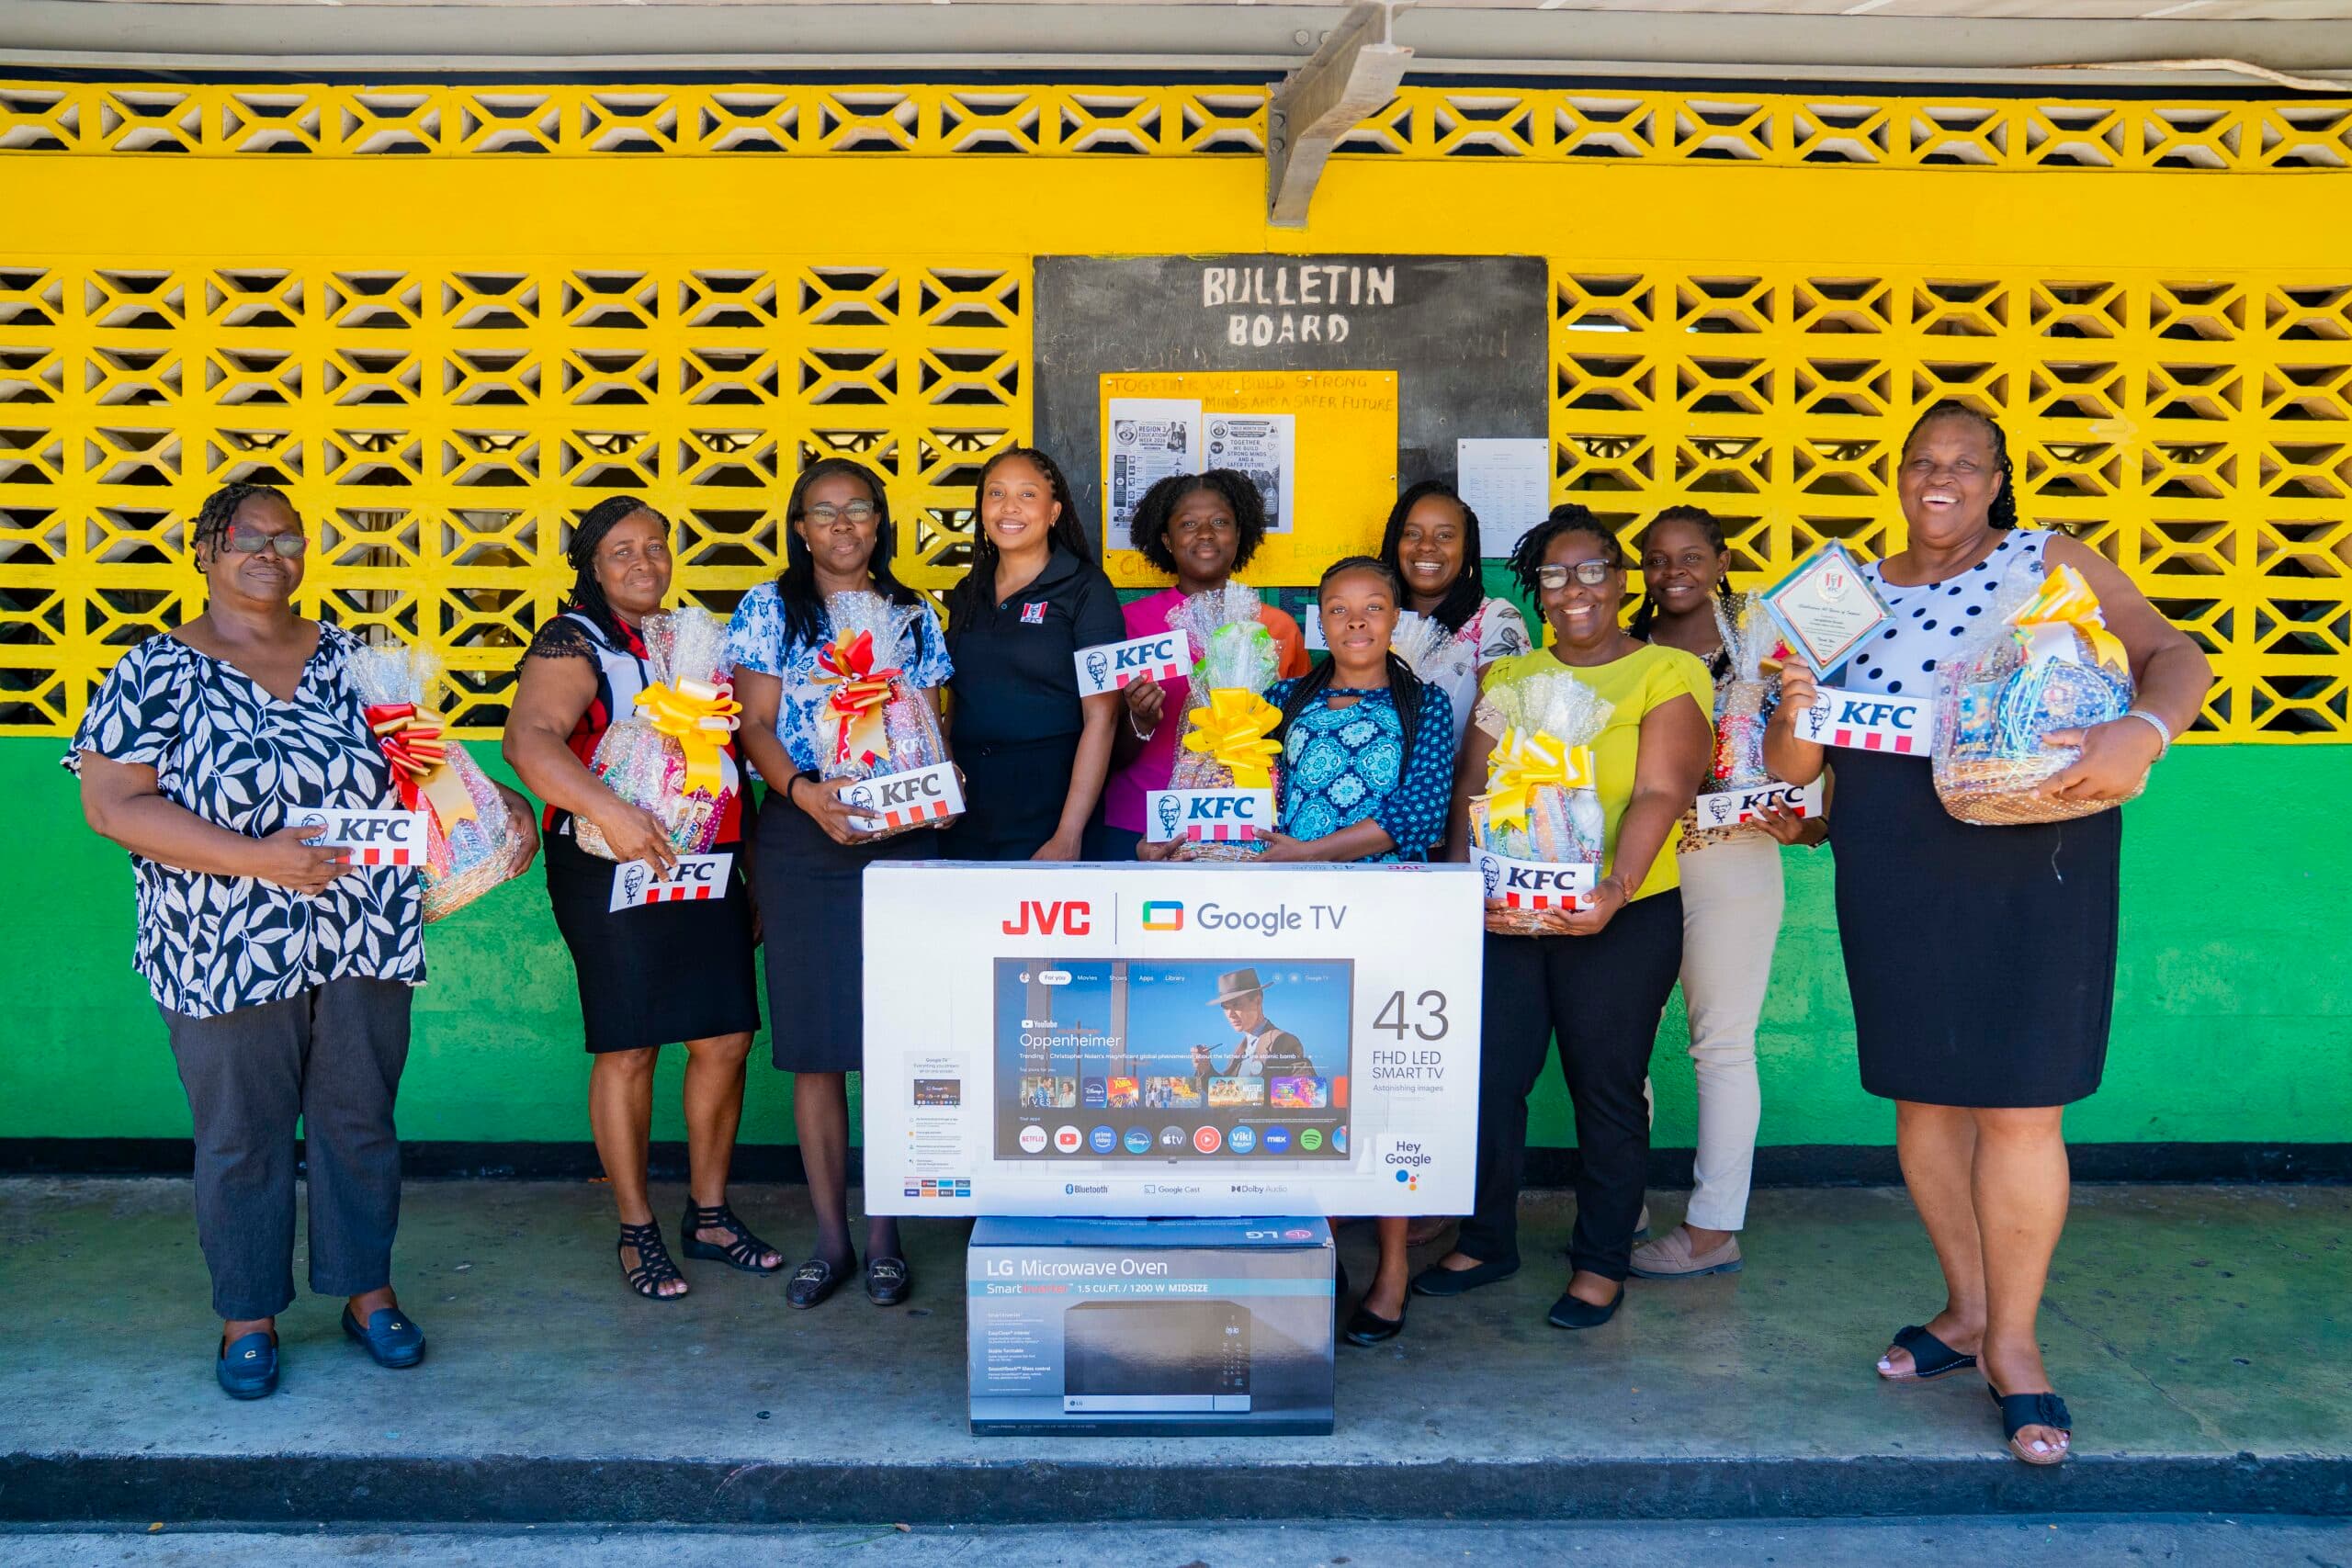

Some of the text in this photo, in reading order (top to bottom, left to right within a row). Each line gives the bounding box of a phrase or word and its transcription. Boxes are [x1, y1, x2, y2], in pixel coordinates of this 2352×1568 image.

[1204, 265, 1395, 308] BULLETIN
[1228, 312, 1350, 347] BOARD
[1204, 376, 1235, 390] WE
[1242, 375, 1284, 390] BUILD
[1296, 375, 1367, 389] STRONG
[1205, 396, 1248, 411] MINDS
[1295, 395, 1336, 409] SAFER
[1343, 396, 1393, 412] FUTURE
[1114, 639, 1173, 670] KFC
[1838, 701, 1917, 729] KFC
[880, 773, 942, 807] KFC
[1739, 786, 1804, 809] KFC
[1187, 796, 1255, 818] KFC
[335, 818, 411, 842] KFC
[1506, 866, 1576, 890] KFC
[1002, 901, 1347, 937] JVC Google TV
[1139, 975, 1154, 983] Apps
[1164, 975, 1186, 983] Library
[1373, 989, 1449, 1041] 43
[1019, 1033, 1122, 1049] Oppenheimer
[1373, 1051, 1441, 1065] FHD LED
[1373, 1067, 1443, 1079] SMART TV
[1373, 1084, 1443, 1093] Astonishing images
[1170, 1134, 1183, 1145] tv
[1396, 1141, 1421, 1154] Hey
[1385, 1154, 1431, 1167] Google
[1158, 1185, 1200, 1194] Google Cast
[1241, 1184, 1287, 1194] Dolby Audio
[987, 1258, 1168, 1276] LG Microwave Oven
[1079, 1285, 1091, 1293] 1.5
[1131, 1284, 1153, 1292] 1200
[1154, 1284, 1164, 1292] W
[1169, 1284, 1209, 1292] MIDSIZE
